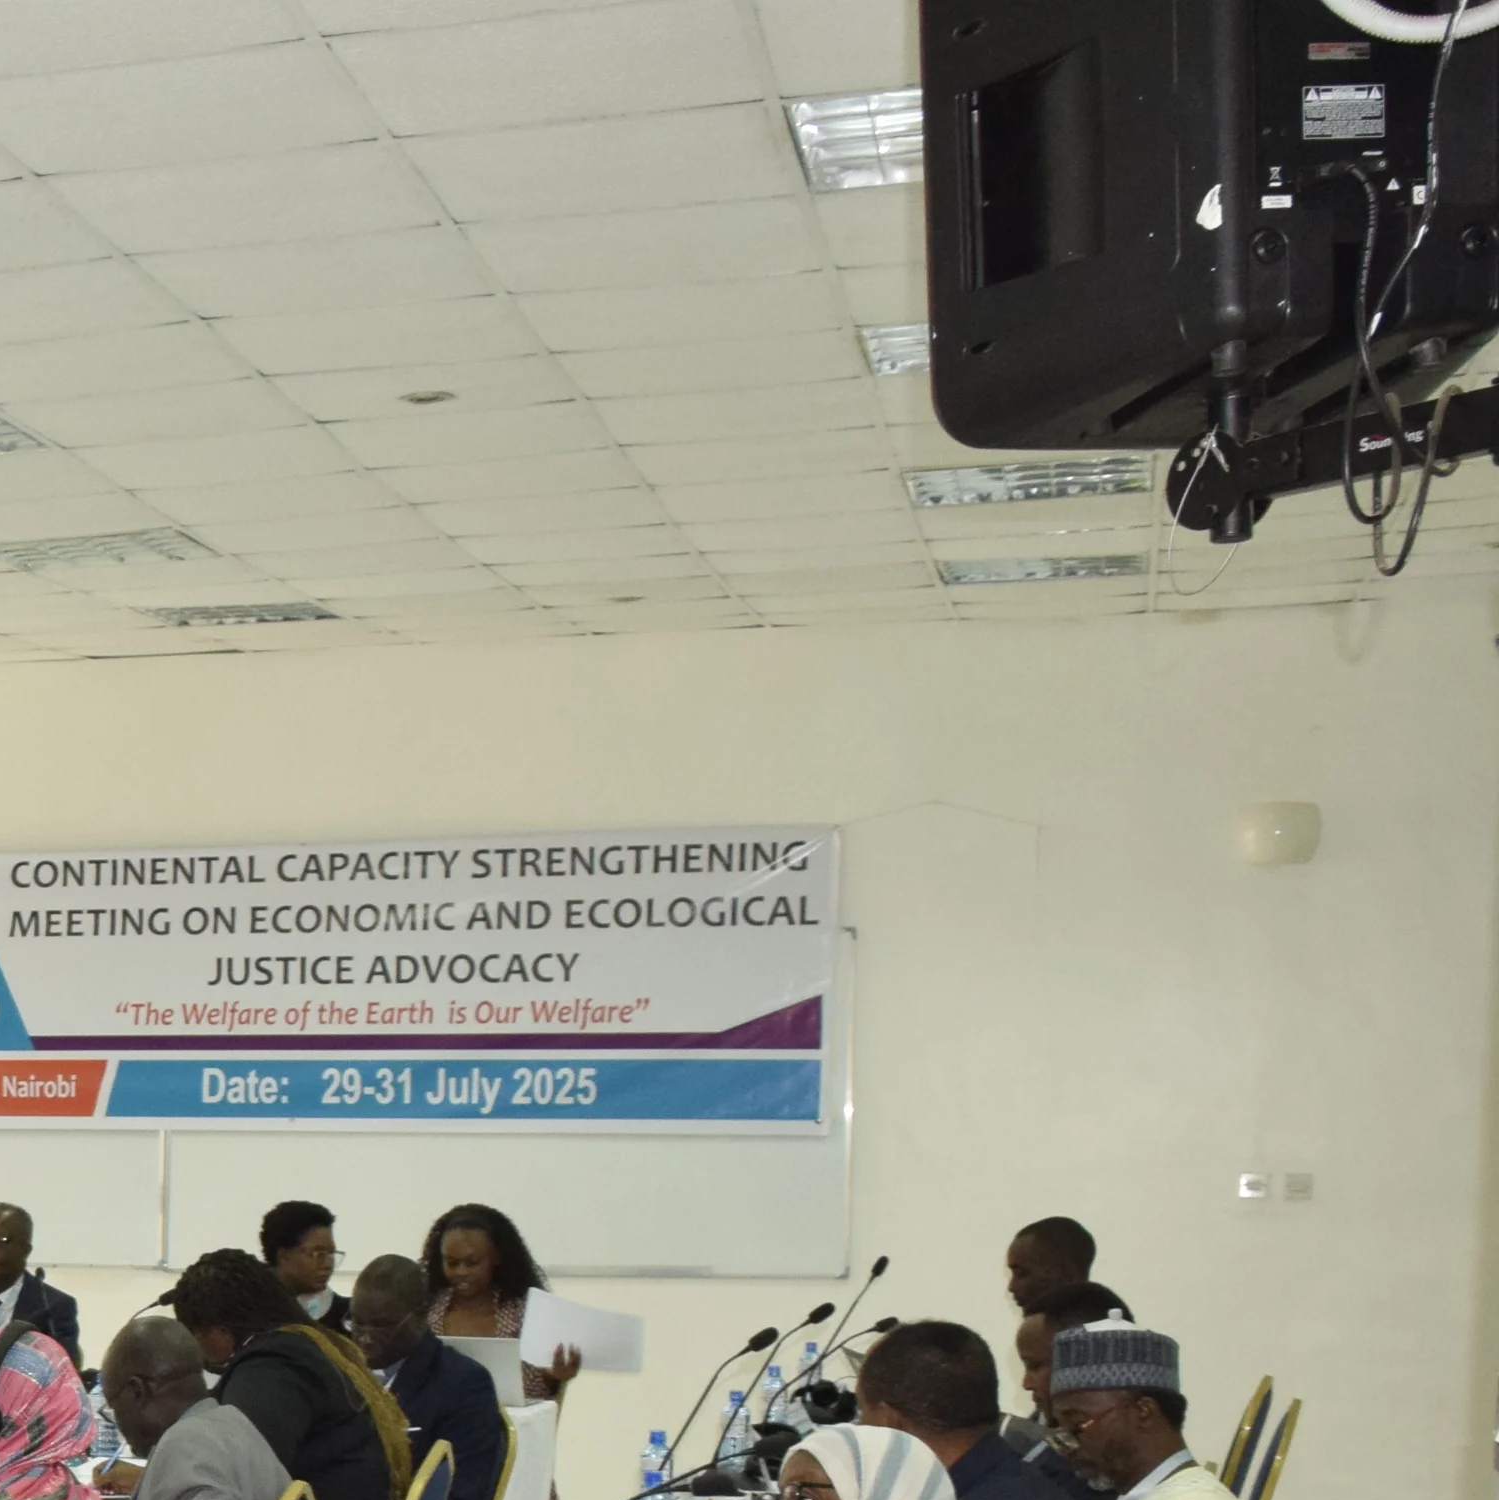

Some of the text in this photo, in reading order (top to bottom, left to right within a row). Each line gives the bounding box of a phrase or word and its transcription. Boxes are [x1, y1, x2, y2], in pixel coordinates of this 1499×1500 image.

[1359, 429, 1423, 452] Souning
[10, 841, 810, 888] CONTINENTAL CAPACITY STRENGTHENING
[8, 896, 820, 938] MEETING ON ECONOMIC AND ECOLOGICAL
[208, 953, 580, 986] JUSTICE ADVOCACY
[182, 1000, 278, 1032] Welfare
[284, 1000, 313, 1032] of
[317, 1000, 358, 1025] the
[365, 1000, 434, 1025] Earth
[448, 999, 467, 1025] is
[474, 1000, 522, 1025] Our
[2, 1074, 77, 1098] Nairobi
[201, 1066, 598, 1115] Date: 29-31 July 2025
